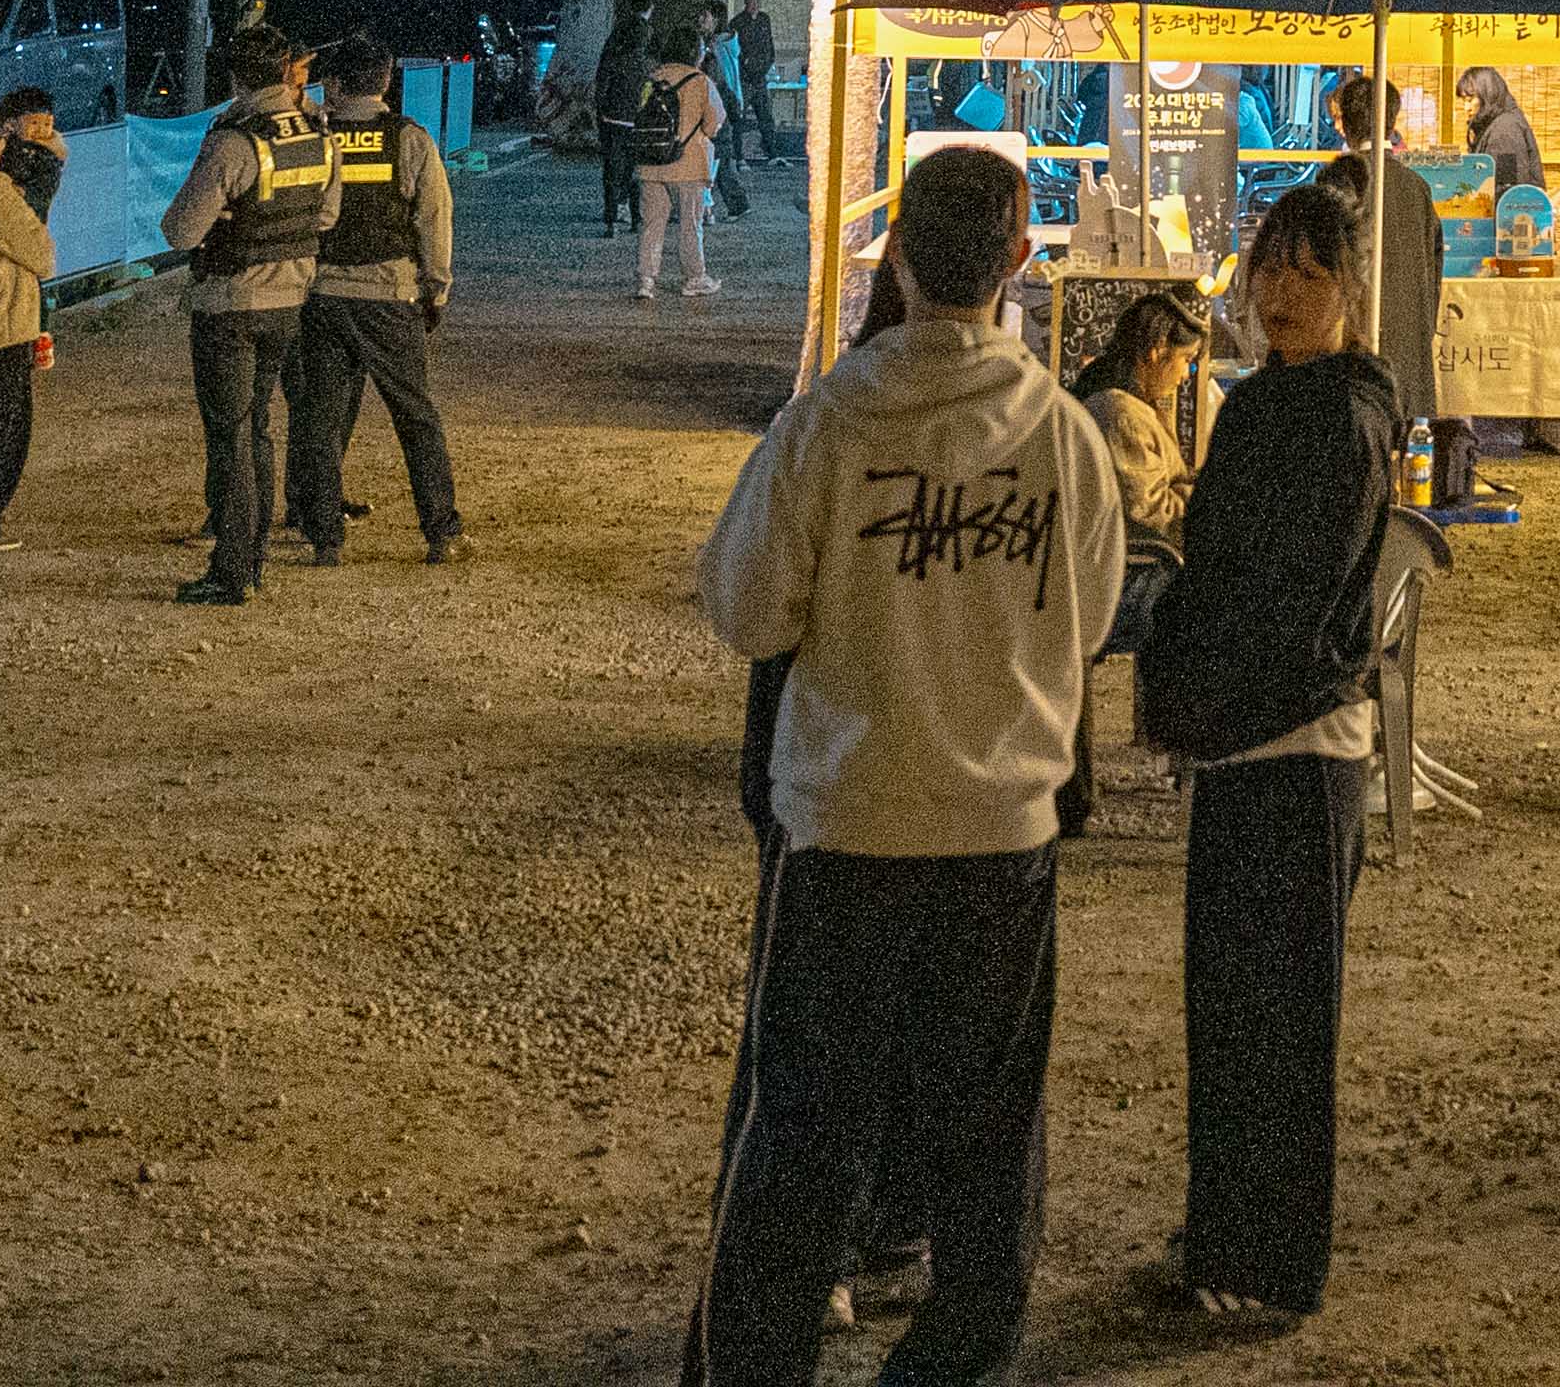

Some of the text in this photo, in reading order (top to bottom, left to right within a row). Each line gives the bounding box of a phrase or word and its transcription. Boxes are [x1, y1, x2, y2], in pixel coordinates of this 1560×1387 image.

[1429, 14, 1500, 39] 주식회사
[1166, 91, 1225, 110] 대한민국
[335, 130, 384, 148] OLICE
[1435, 345, 1512, 373] 삽시도
